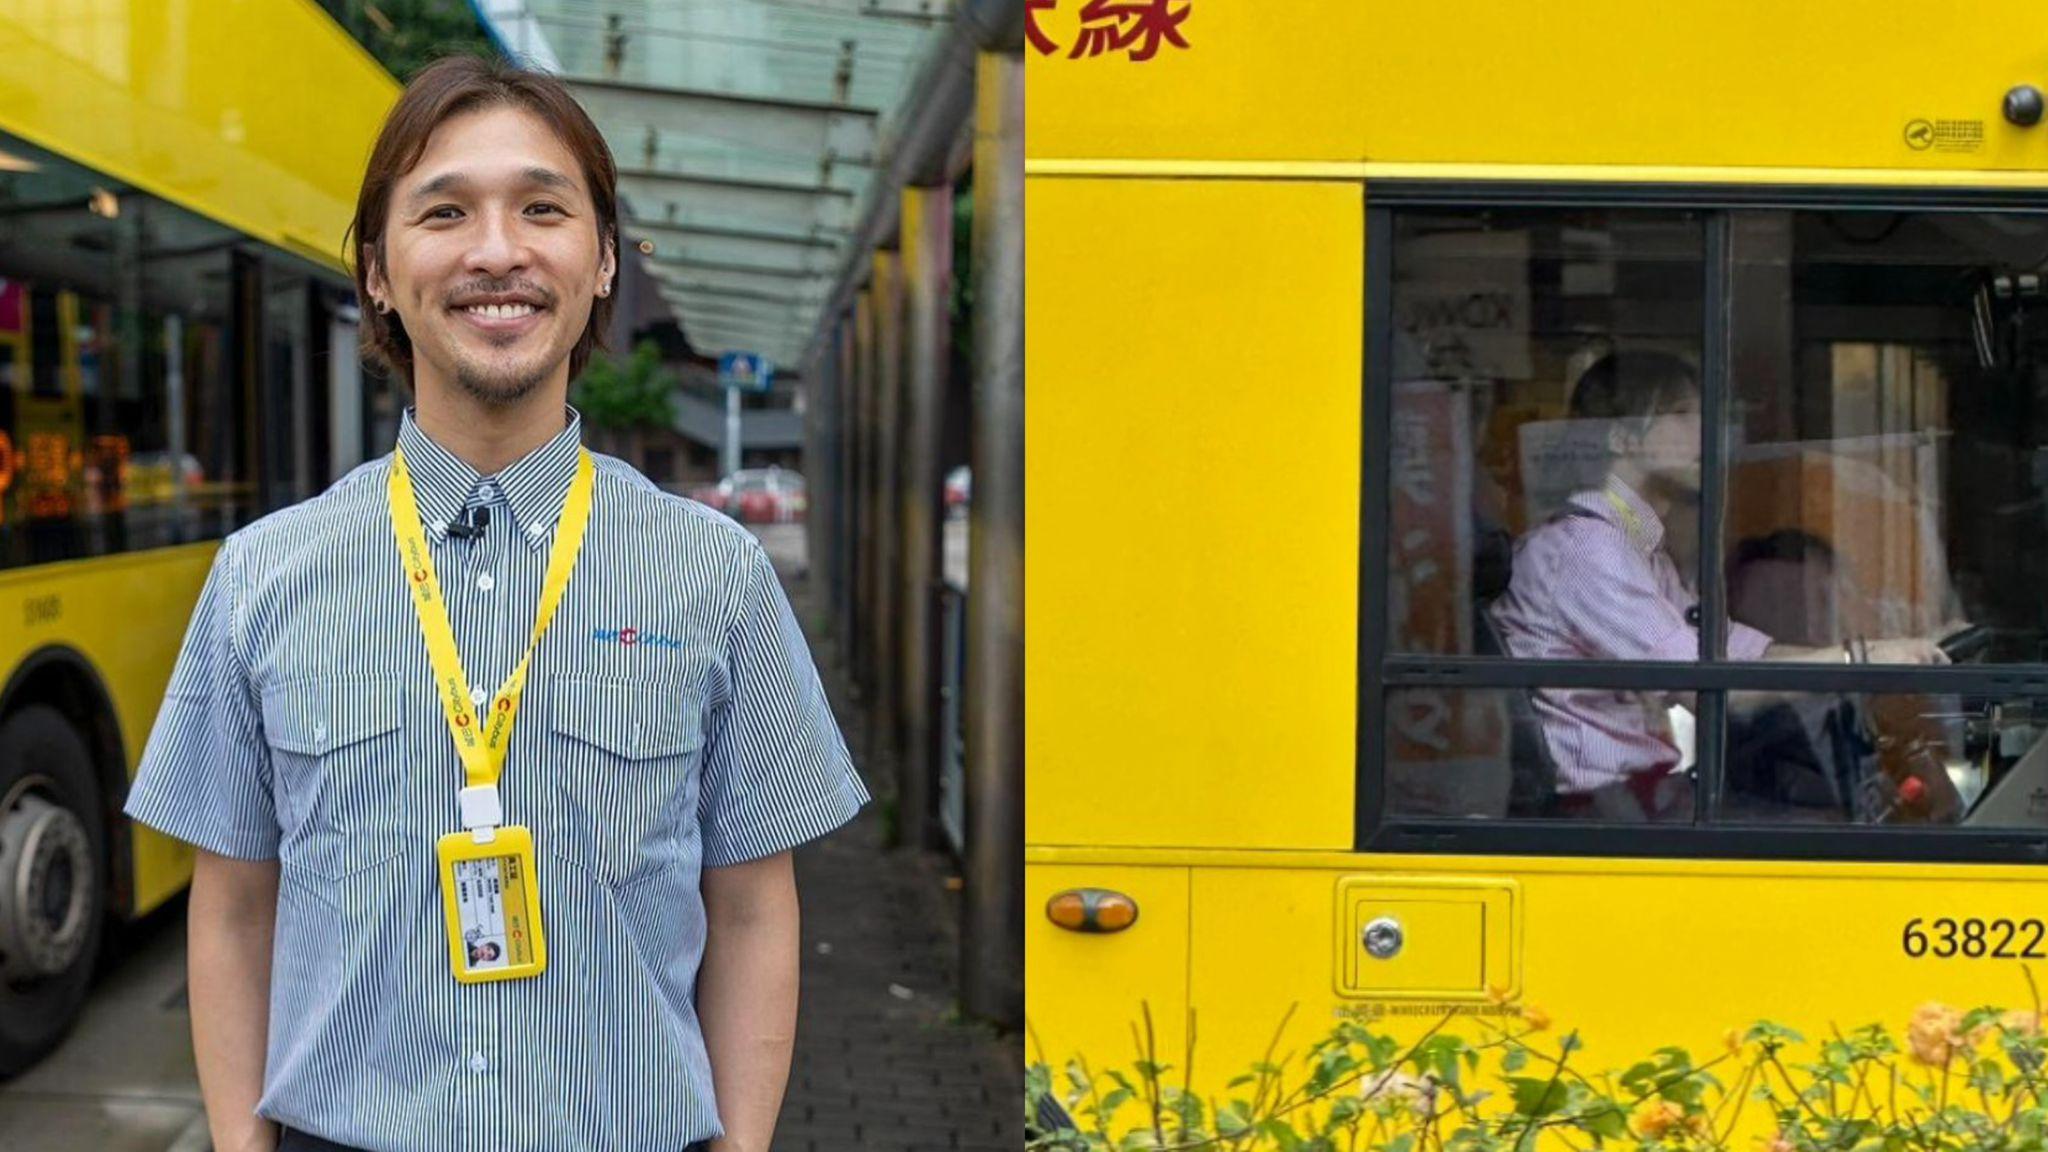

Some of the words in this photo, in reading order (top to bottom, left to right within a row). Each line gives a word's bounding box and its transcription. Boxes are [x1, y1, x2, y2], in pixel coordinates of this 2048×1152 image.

[448, 678, 463, 713] Citybus
[490, 713, 506, 748] Citybus
[1902, 917, 2047, 959] 63822
